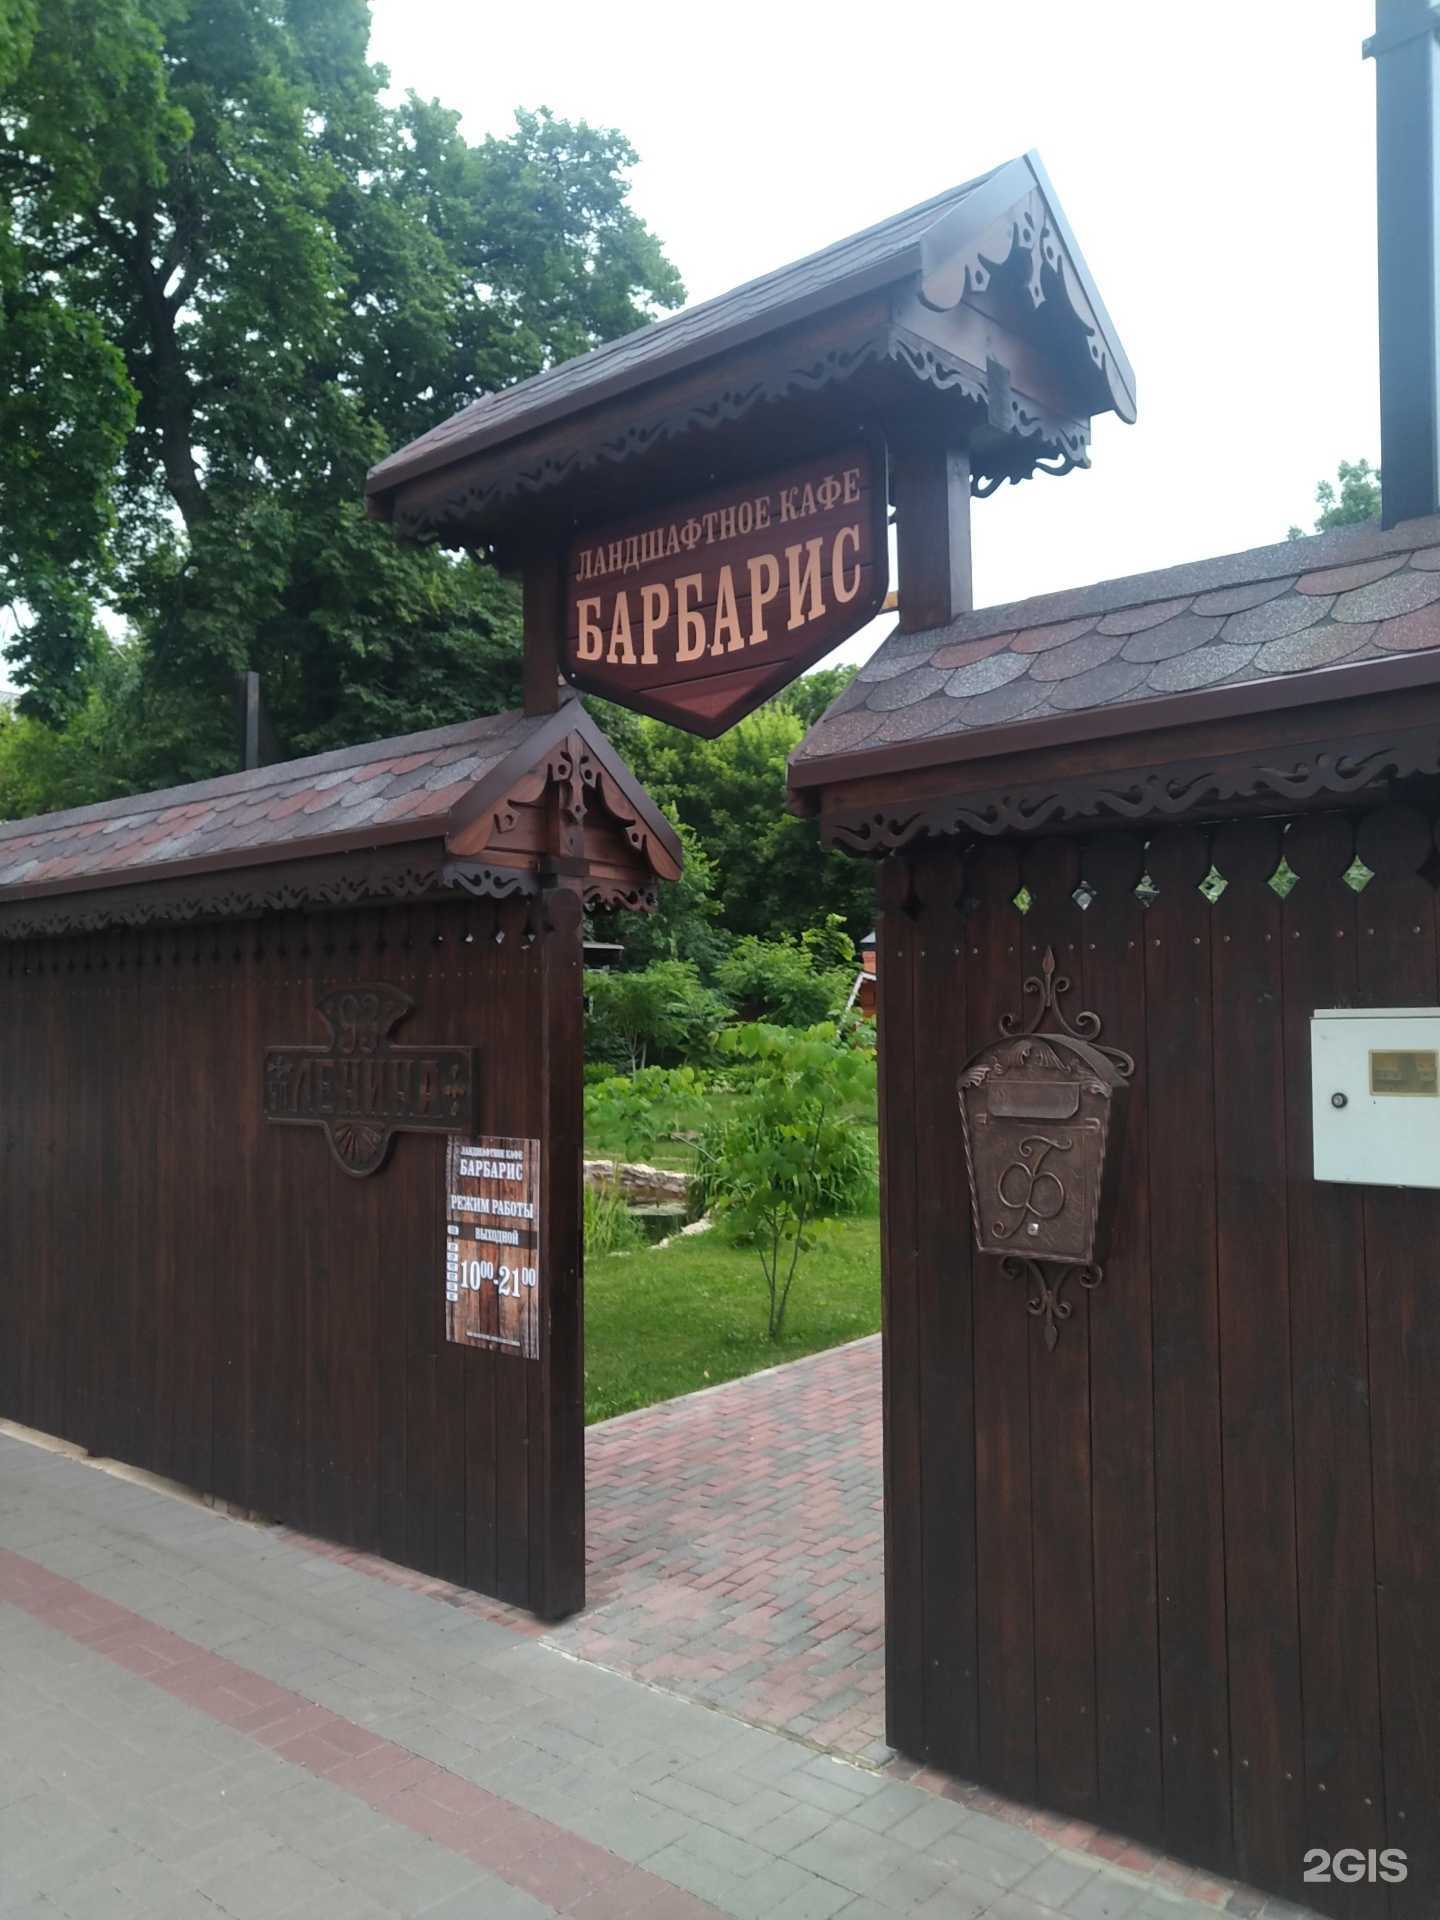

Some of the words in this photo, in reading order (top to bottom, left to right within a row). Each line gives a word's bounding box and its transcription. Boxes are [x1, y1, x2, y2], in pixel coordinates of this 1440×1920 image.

[576, 496, 771, 582] ЛАНДШАФТНОЕ
[779, 468, 862, 523] КАФЕ
[576, 524, 862, 665] БАРБАРИС
[459, 1158, 523, 1181] БАРБАРИС
[451, 1195, 490, 1213] РЕЖИМ
[491, 1199, 534, 1219] РАБОТЫ
[475, 1226, 519, 1246] ВЫХОДНОЙ
